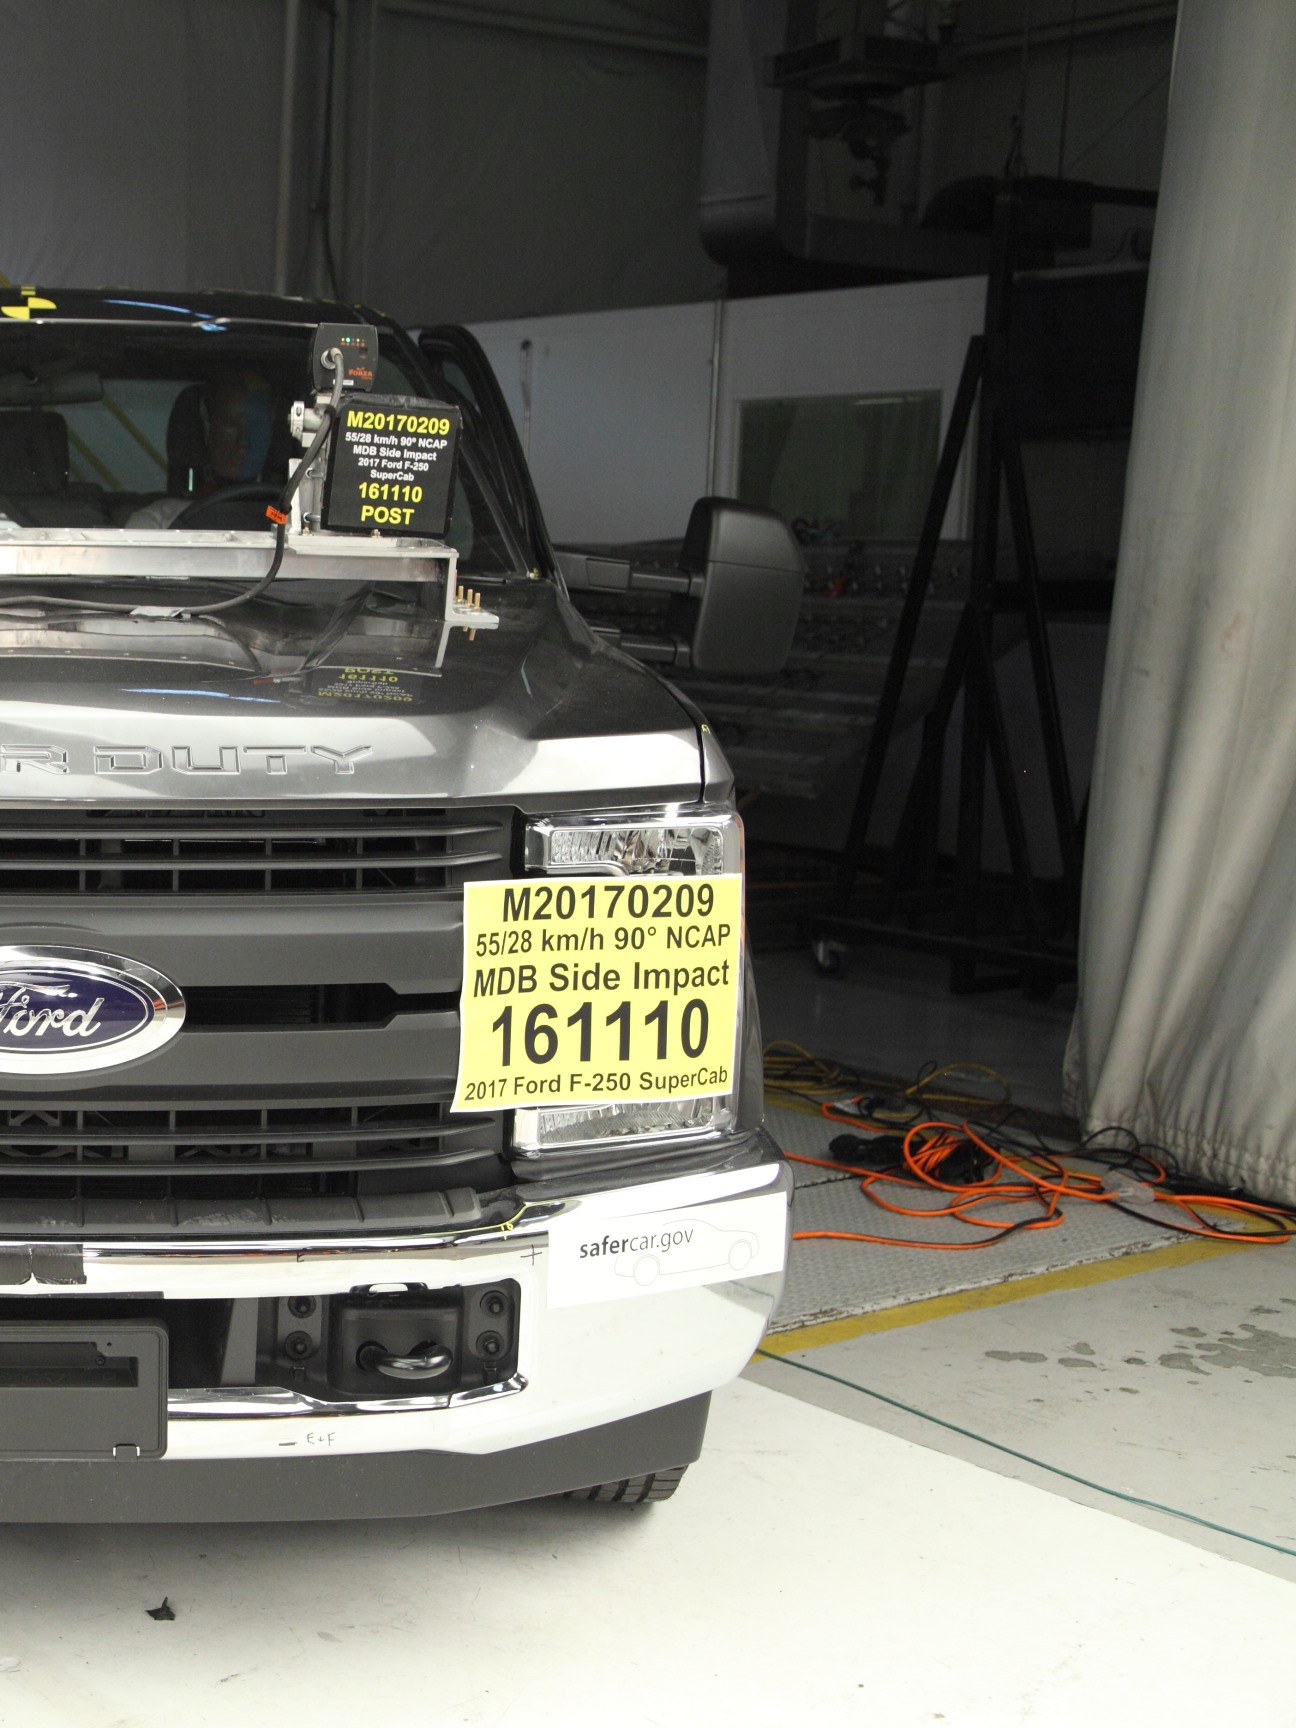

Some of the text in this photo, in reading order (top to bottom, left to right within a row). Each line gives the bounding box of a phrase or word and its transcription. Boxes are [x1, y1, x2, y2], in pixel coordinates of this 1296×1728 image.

[347, 411, 450, 435] M20170209
[345, 432, 371, 443] 55/28
[374, 435, 398, 446] km/h
[418, 438, 448, 449] NCAP
[353, 446, 437, 461] MDB Side Impact
[358, 458, 429, 471] 2017 Ford F-250
[370, 470, 415, 482] SuperCab
[359, 482, 422, 503] 161110
[361, 505, 414, 525] POST
[93, 744, 373, 775] DUTY
[503, 883, 715, 922] M20170209
[476, 923, 731, 957] 55/28 km/h 90° NCAP
[473, 959, 730, 998] MDB Side Impact
[492, 998, 709, 1067] 161110
[464, 1065, 728, 1101] 2017 Ford F-250 SuperCab
[579, 1228, 694, 1259] safercar.gov
